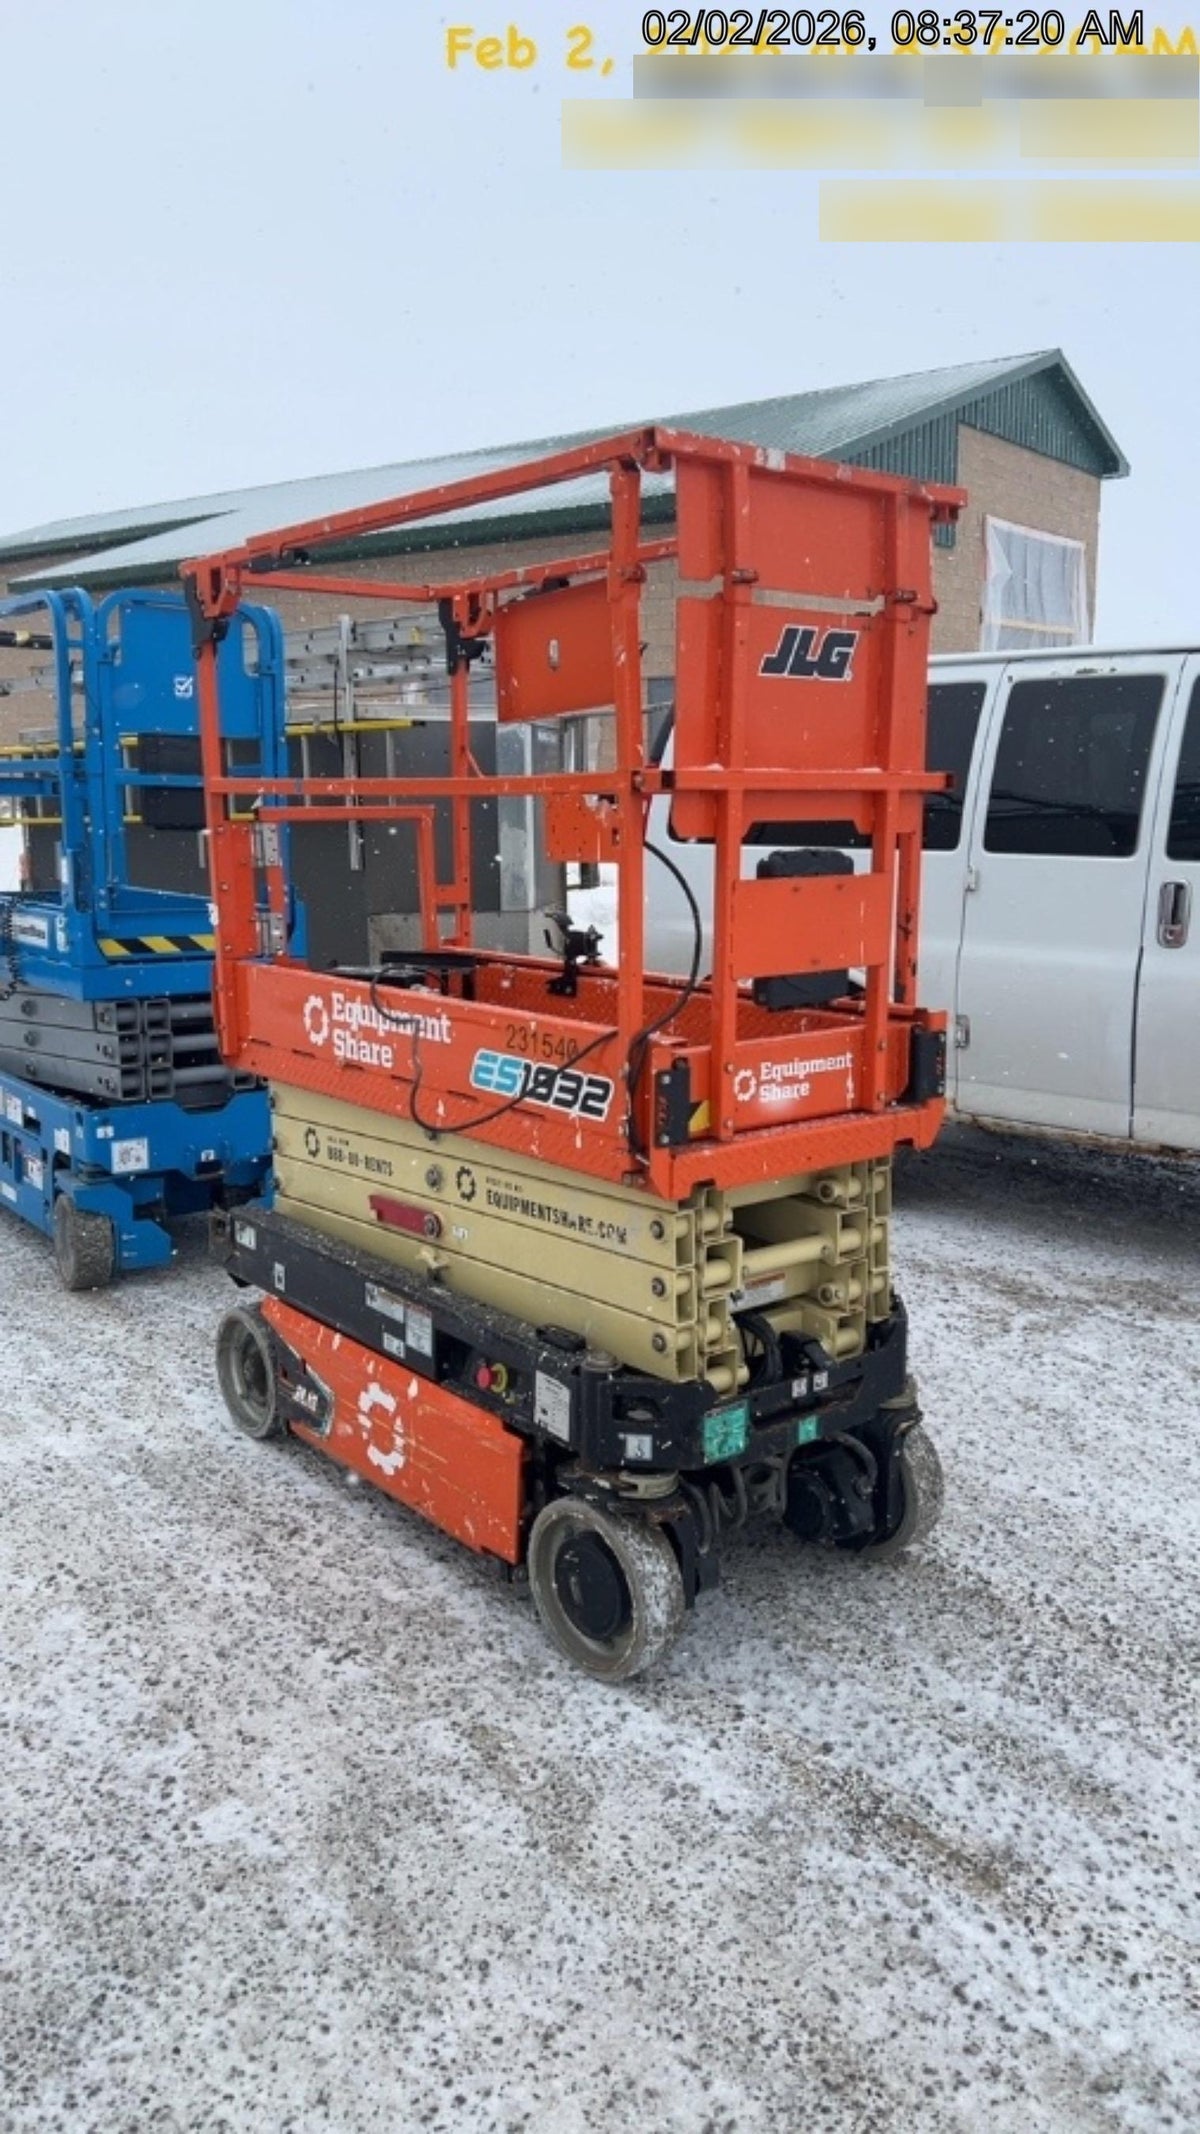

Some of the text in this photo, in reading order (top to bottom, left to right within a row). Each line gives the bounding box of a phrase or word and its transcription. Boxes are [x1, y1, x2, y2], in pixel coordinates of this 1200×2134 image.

[758, 623, 859, 682] JLG
[331, 991, 451, 1044] Equipment
[333, 1027, 393, 1068] Share
[506, 1023, 580, 1060] 231540
[760, 1052, 852, 1081] Equipment
[760, 1082, 810, 1103] Share
